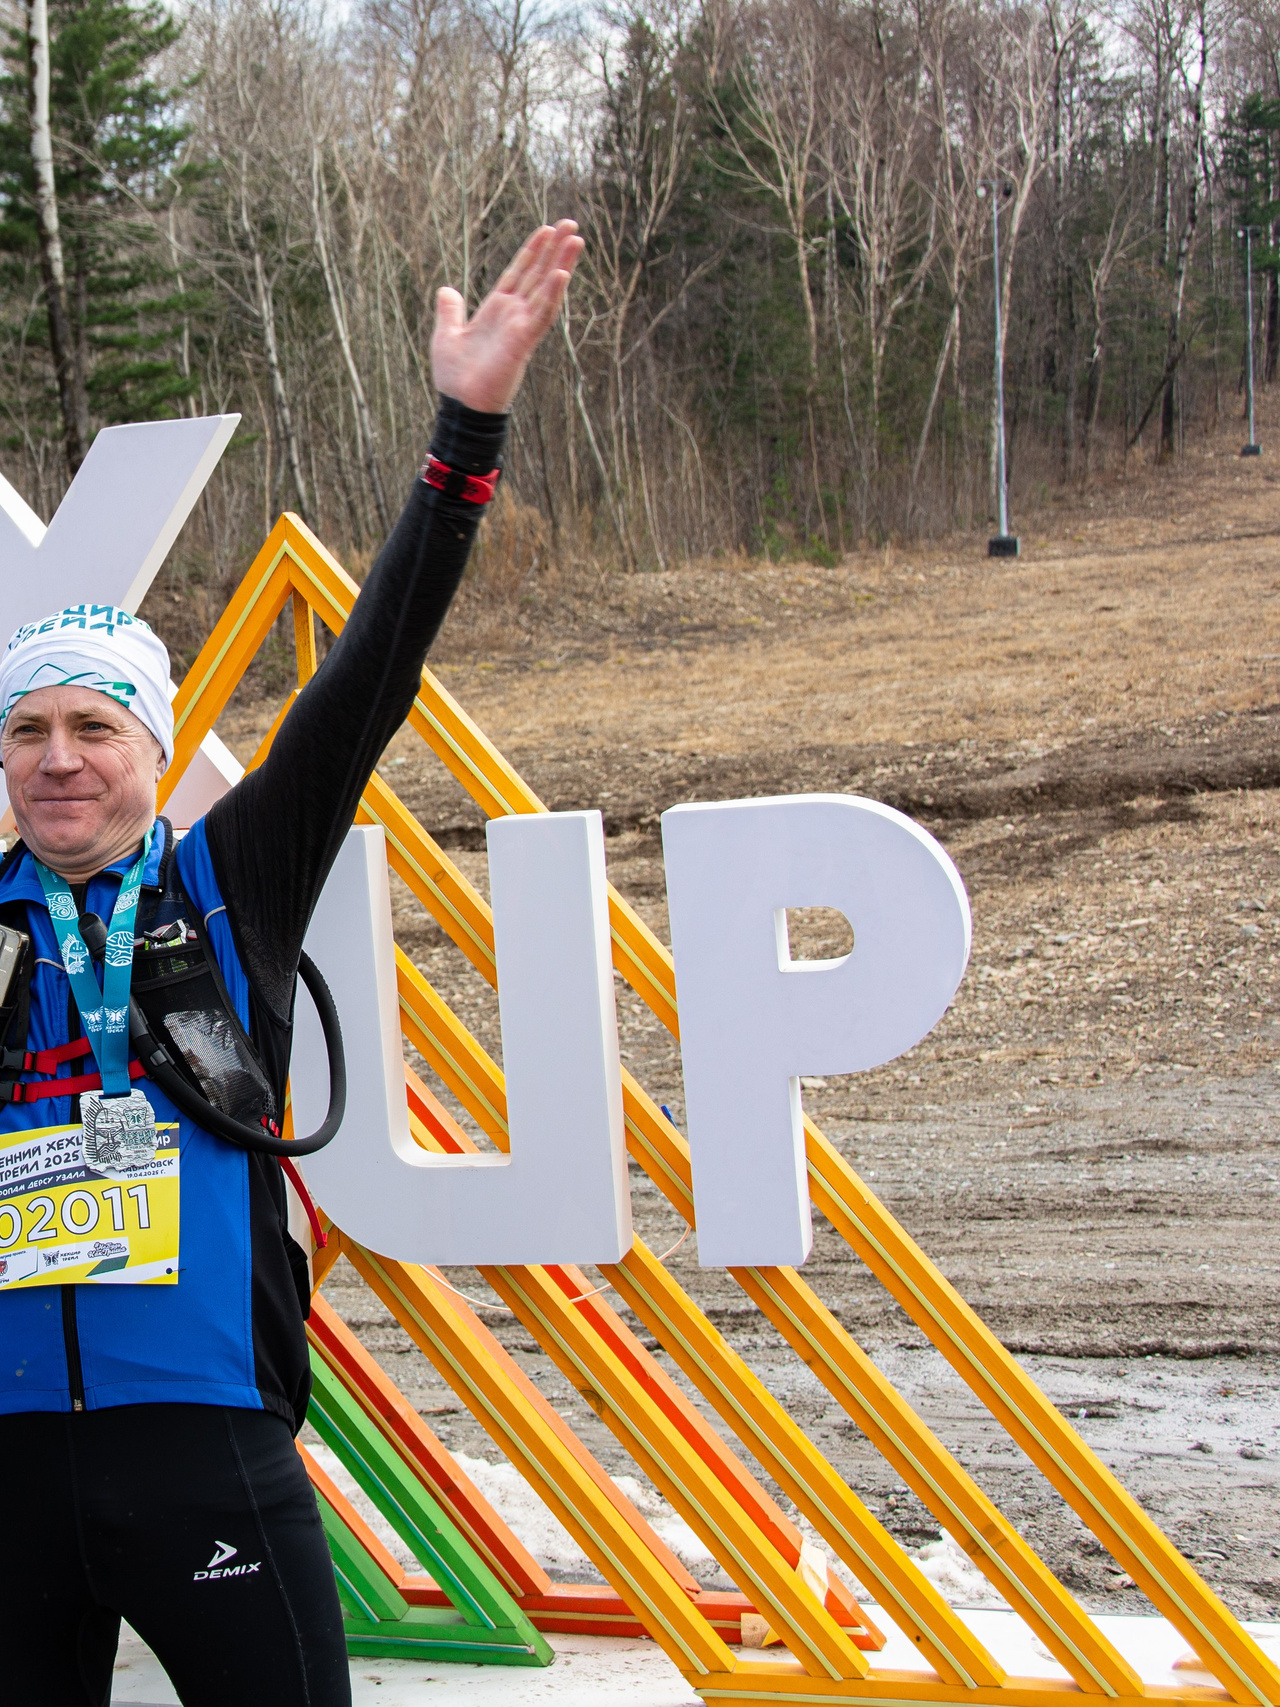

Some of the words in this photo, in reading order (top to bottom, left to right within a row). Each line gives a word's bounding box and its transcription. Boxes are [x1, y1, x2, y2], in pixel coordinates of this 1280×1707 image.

[44, 1150, 80, 1169] 2025
[27, 1176, 54, 1190] ДЕРСУ
[55, 1170, 86, 1182] УЗАЛА
[193, 1561, 262, 1581] DEMIX
